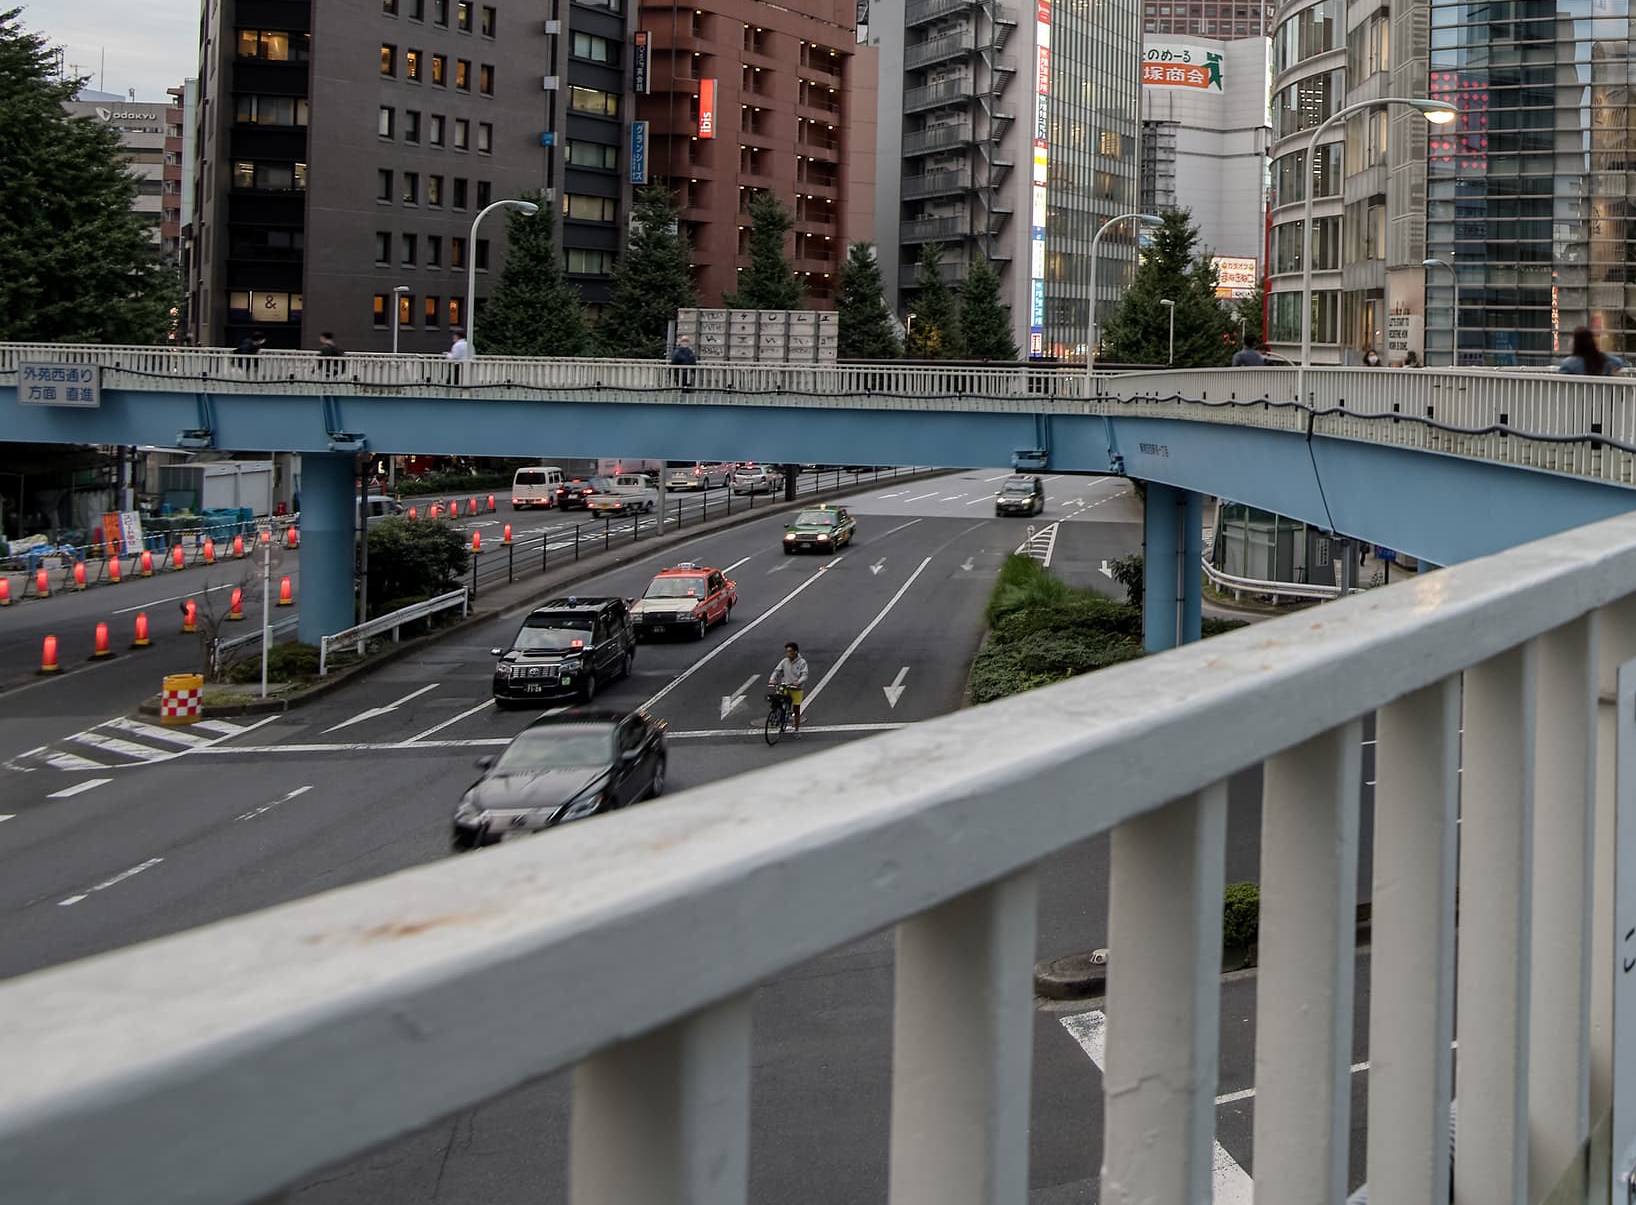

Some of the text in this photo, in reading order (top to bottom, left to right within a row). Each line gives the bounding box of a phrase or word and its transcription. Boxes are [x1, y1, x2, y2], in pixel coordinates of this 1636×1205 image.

[1142, 49, 1191, 62] のめーる
[700, 111, 712, 133] ibis
[24, 366, 93, 383] 外苑西通り
[29, 386, 94, 402] 方面 直進
